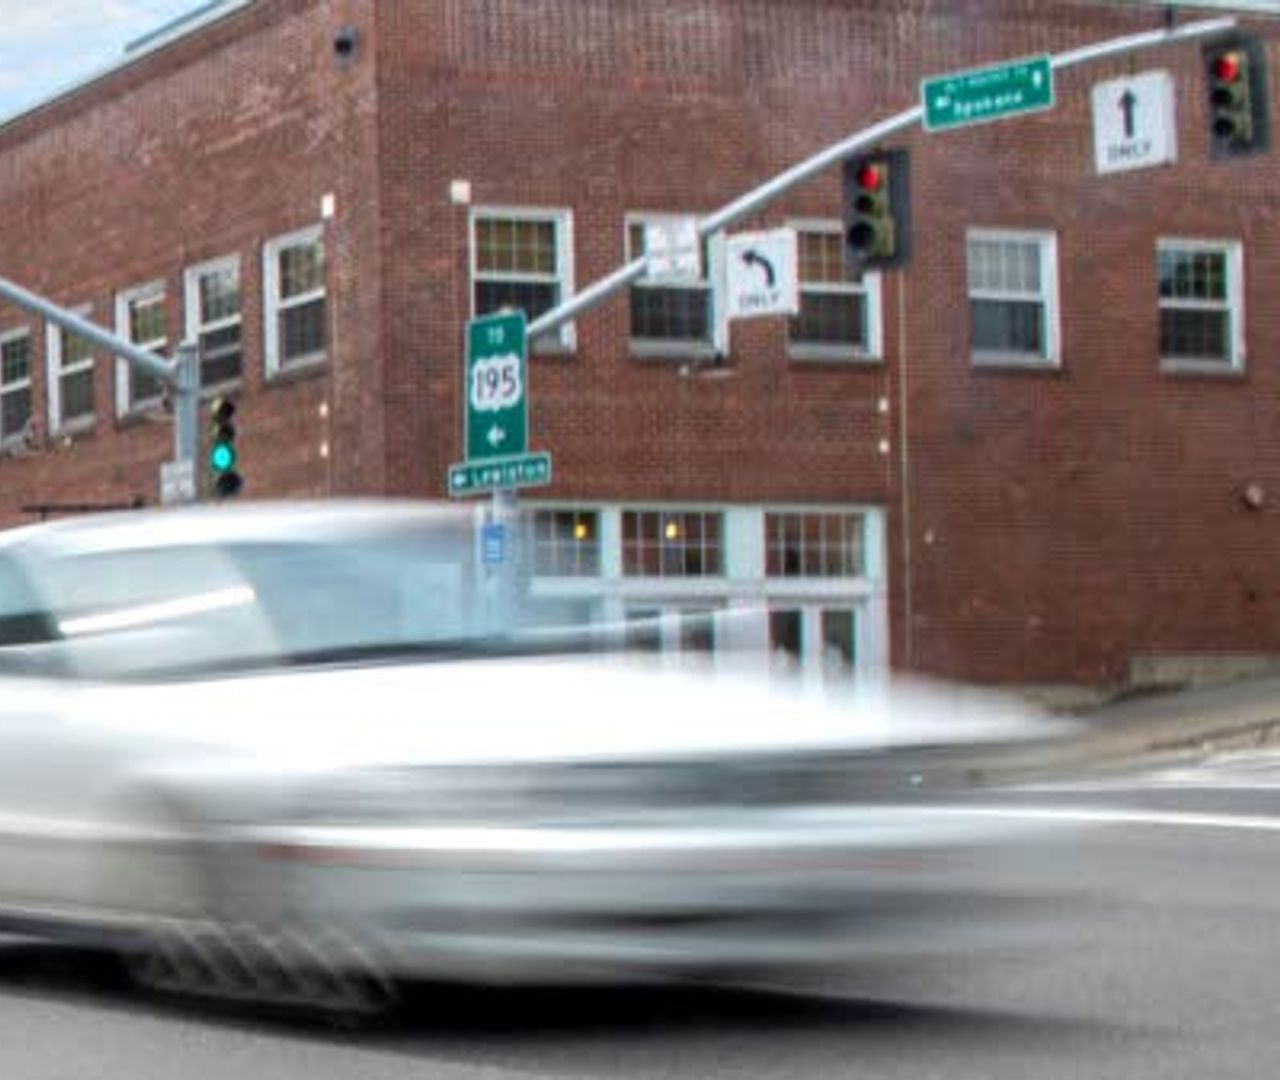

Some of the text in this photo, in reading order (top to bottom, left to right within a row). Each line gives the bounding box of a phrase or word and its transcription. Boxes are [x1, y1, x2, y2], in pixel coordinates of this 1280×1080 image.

[953, 89, 1023, 117] Spokane
[1107, 141, 1152, 162] ONLY
[739, 291, 780, 309] ONLY
[487, 326, 505, 344] TO
[476, 365, 517, 400] 195
[471, 462, 546, 487] Lewiston
